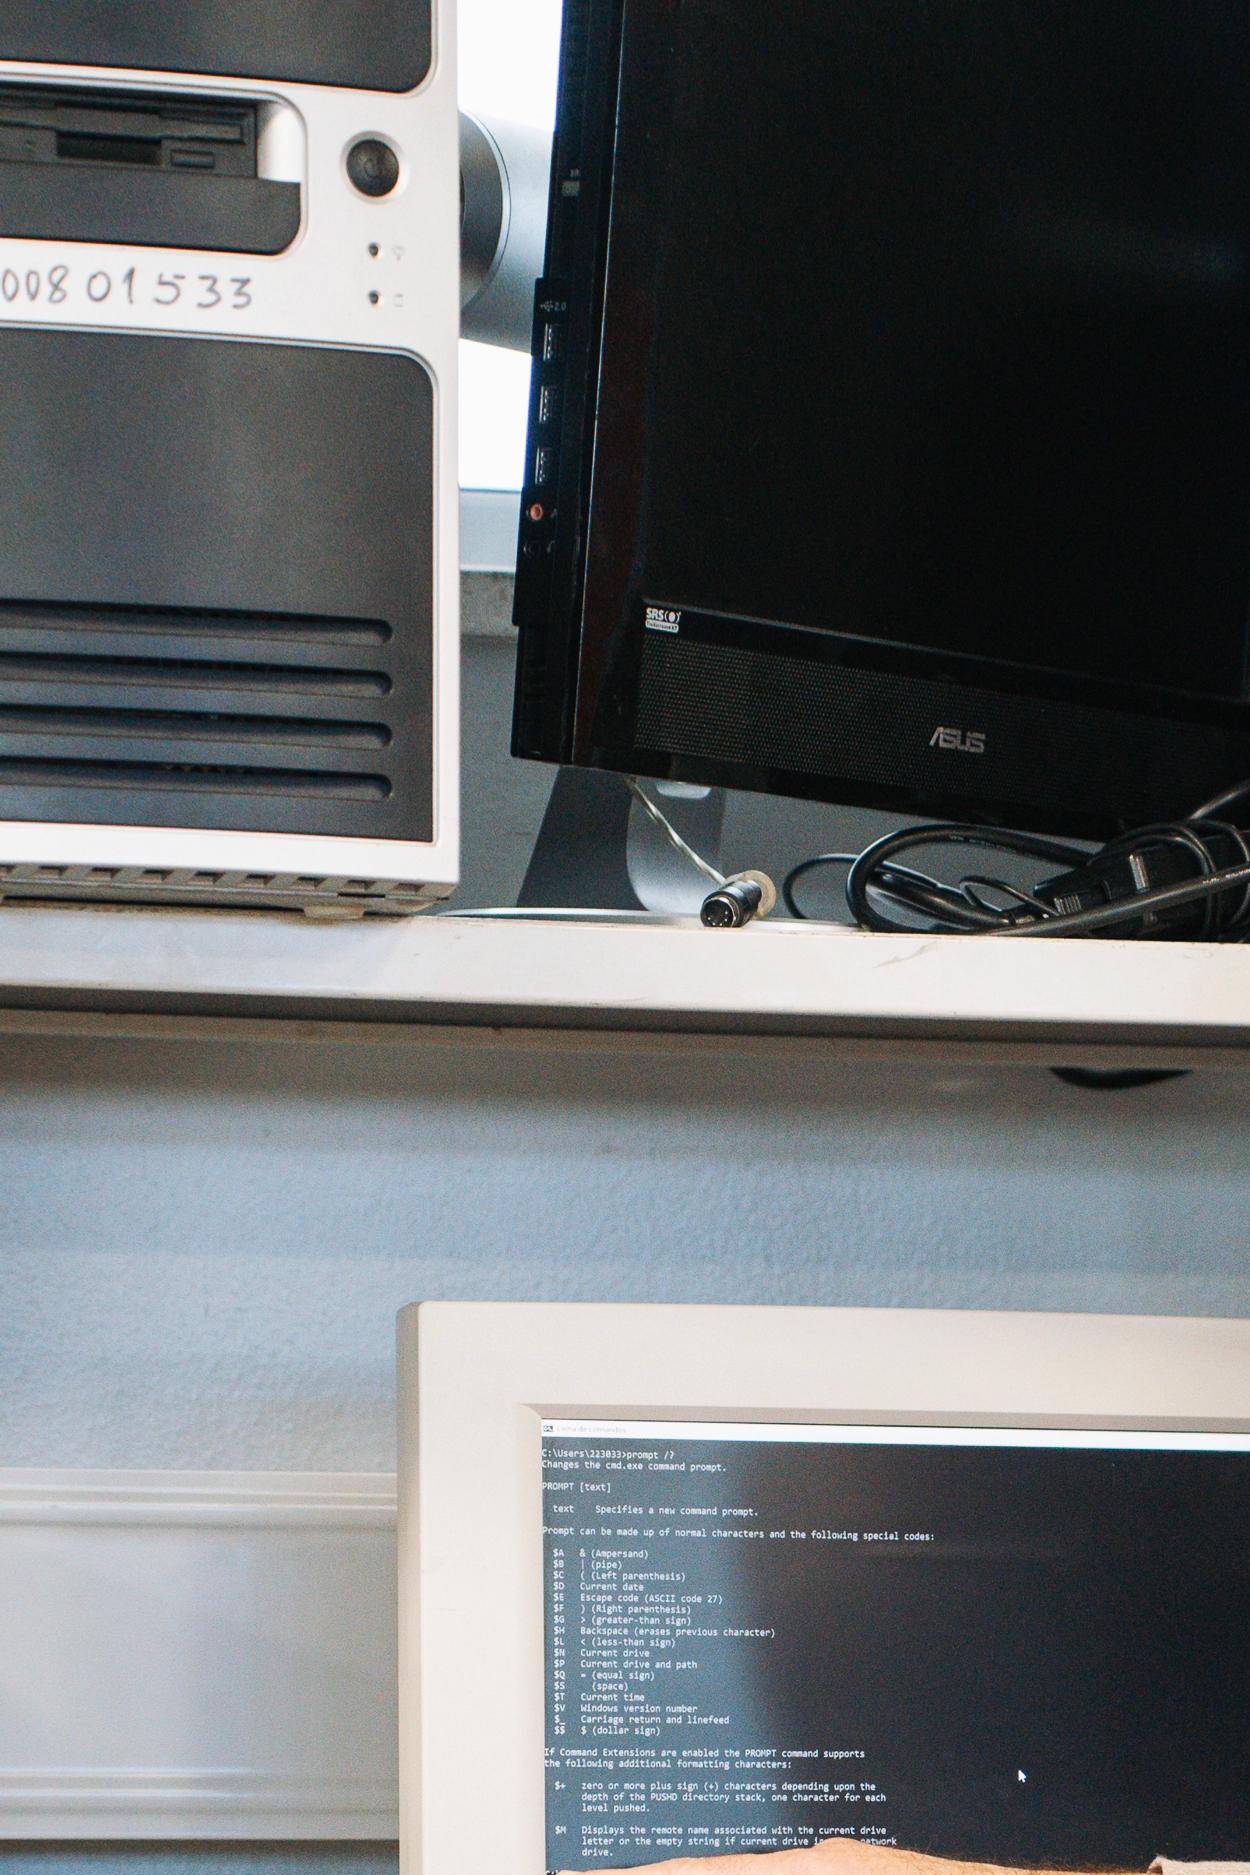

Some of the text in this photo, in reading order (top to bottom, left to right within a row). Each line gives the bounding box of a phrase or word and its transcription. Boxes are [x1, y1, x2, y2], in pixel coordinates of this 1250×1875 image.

[929, 726, 986, 754] ASUS
[542, 1461, 725, 1473] Changes the cmd.exe command prompt.
[542, 1482, 610, 1493] PROMPT [text]
[554, 1505, 573, 1513] text
[596, 1506, 643, 1516] Specifies
[681, 1507, 717, 1515] command
[723, 1508, 757, 1518] prompt.
[542, 1527, 574, 1537] Prompt
[601, 1527, 611, 1536] be
[617, 1528, 638, 1536] made
[644, 1530, 654, 1538] up
[659, 1528, 669, 1536] of
[675, 1529, 706, 1537] normal
[712, 1529, 764, 1537] characters
[770, 1530, 785, 1538] and
[790, 1530, 806, 1538] the
[811, 1530, 858, 1541] following
[864, 1531, 898, 1541] special
[905, 1532, 933, 1540] codes:
[554, 1549, 648, 1559] $A (Ampersand)
[592, 1560, 621, 1570] (pipe)
[554, 1571, 685, 1582] $C (Left parenthesis)
[580, 1582, 643, 1591] Current date
[554, 1593, 722, 1604] $E Escape code (ASCII code 27)
[554, 1604, 690, 1615] $F (Right parenthesis)
[554, 1615, 690, 1626] $G (greater-than sign)
[554, 1626, 774, 1638] $H Backspace (erases previous character)
[554, 1637, 675, 1648] $L (less-than sign)
[581, 1648, 649, 1657] Current drive
[555, 1659, 697, 1670] $P Current drive and path
[592, 1670, 654, 1681] (equal sign)
[593, 1681, 627, 1691] (space)
[555, 1692, 644, 1702] $T Current time
[555, 1703, 697, 1713] $V Windows version number
[581, 1715, 729, 1725] Carriage return and linefeed
[593, 1726, 660, 1736] (dollar sign)
[544, 1748, 554, 1756] If
[560, 1748, 597, 1756] Command
[603, 1748, 655, 1756] Extensions
[683, 1748, 718, 1757] enabled
[725, 1748, 739, 1757] the
[746, 1749, 776, 1757] PROMPT
[782, 1749, 818, 1757] command
[824, 1749, 864, 1759] supports
[545, 1758, 791, 1769] the following additional formatting characters:
[651, 1781, 671, 1791] plus
[678, 1781, 698, 1791] sign
[725, 1782, 776, 1790] characters
[782, 1782, 829, 1792] depending
[834, 1784, 854, 1792] upon
[860, 1782, 875, 1790] the
[582, 1792, 608, 1802] depth
[614, 1792, 624, 1801] of
[630, 1792, 645, 1801] the
[651, 1792, 677, 1801] PUSHD
[683, 1792, 729, 1803] directory
[736, 1793, 765, 1803] stack,
[793, 1793, 839, 1801] character
[845, 1793, 860, 1801] for
[866, 1793, 886, 1801] each
[583, 1803, 649, 1814] level pushed.
[582, 1825, 624, 1835] Displays
[630, 1825, 645, 1834] the
[652, 1825, 682, 1834] remote
[715, 1826, 766, 1834] associated
[772, 1826, 792, 1834] with
[799, 1826, 813, 1834] the
[819, 1826, 854, 1834] current
[861, 1826, 886, 1834] drive
[583, 1836, 613, 1845] letter
[636, 1837, 651, 1845] the
[657, 1837, 682, 1847] empty
[689, 1837, 719, 1847] string
[726, 1837, 735, 1845] if
[741, 1837, 776, 1845] current
[783, 1837, 808, 1845] drive
[582, 1847, 612, 1856] drive.
